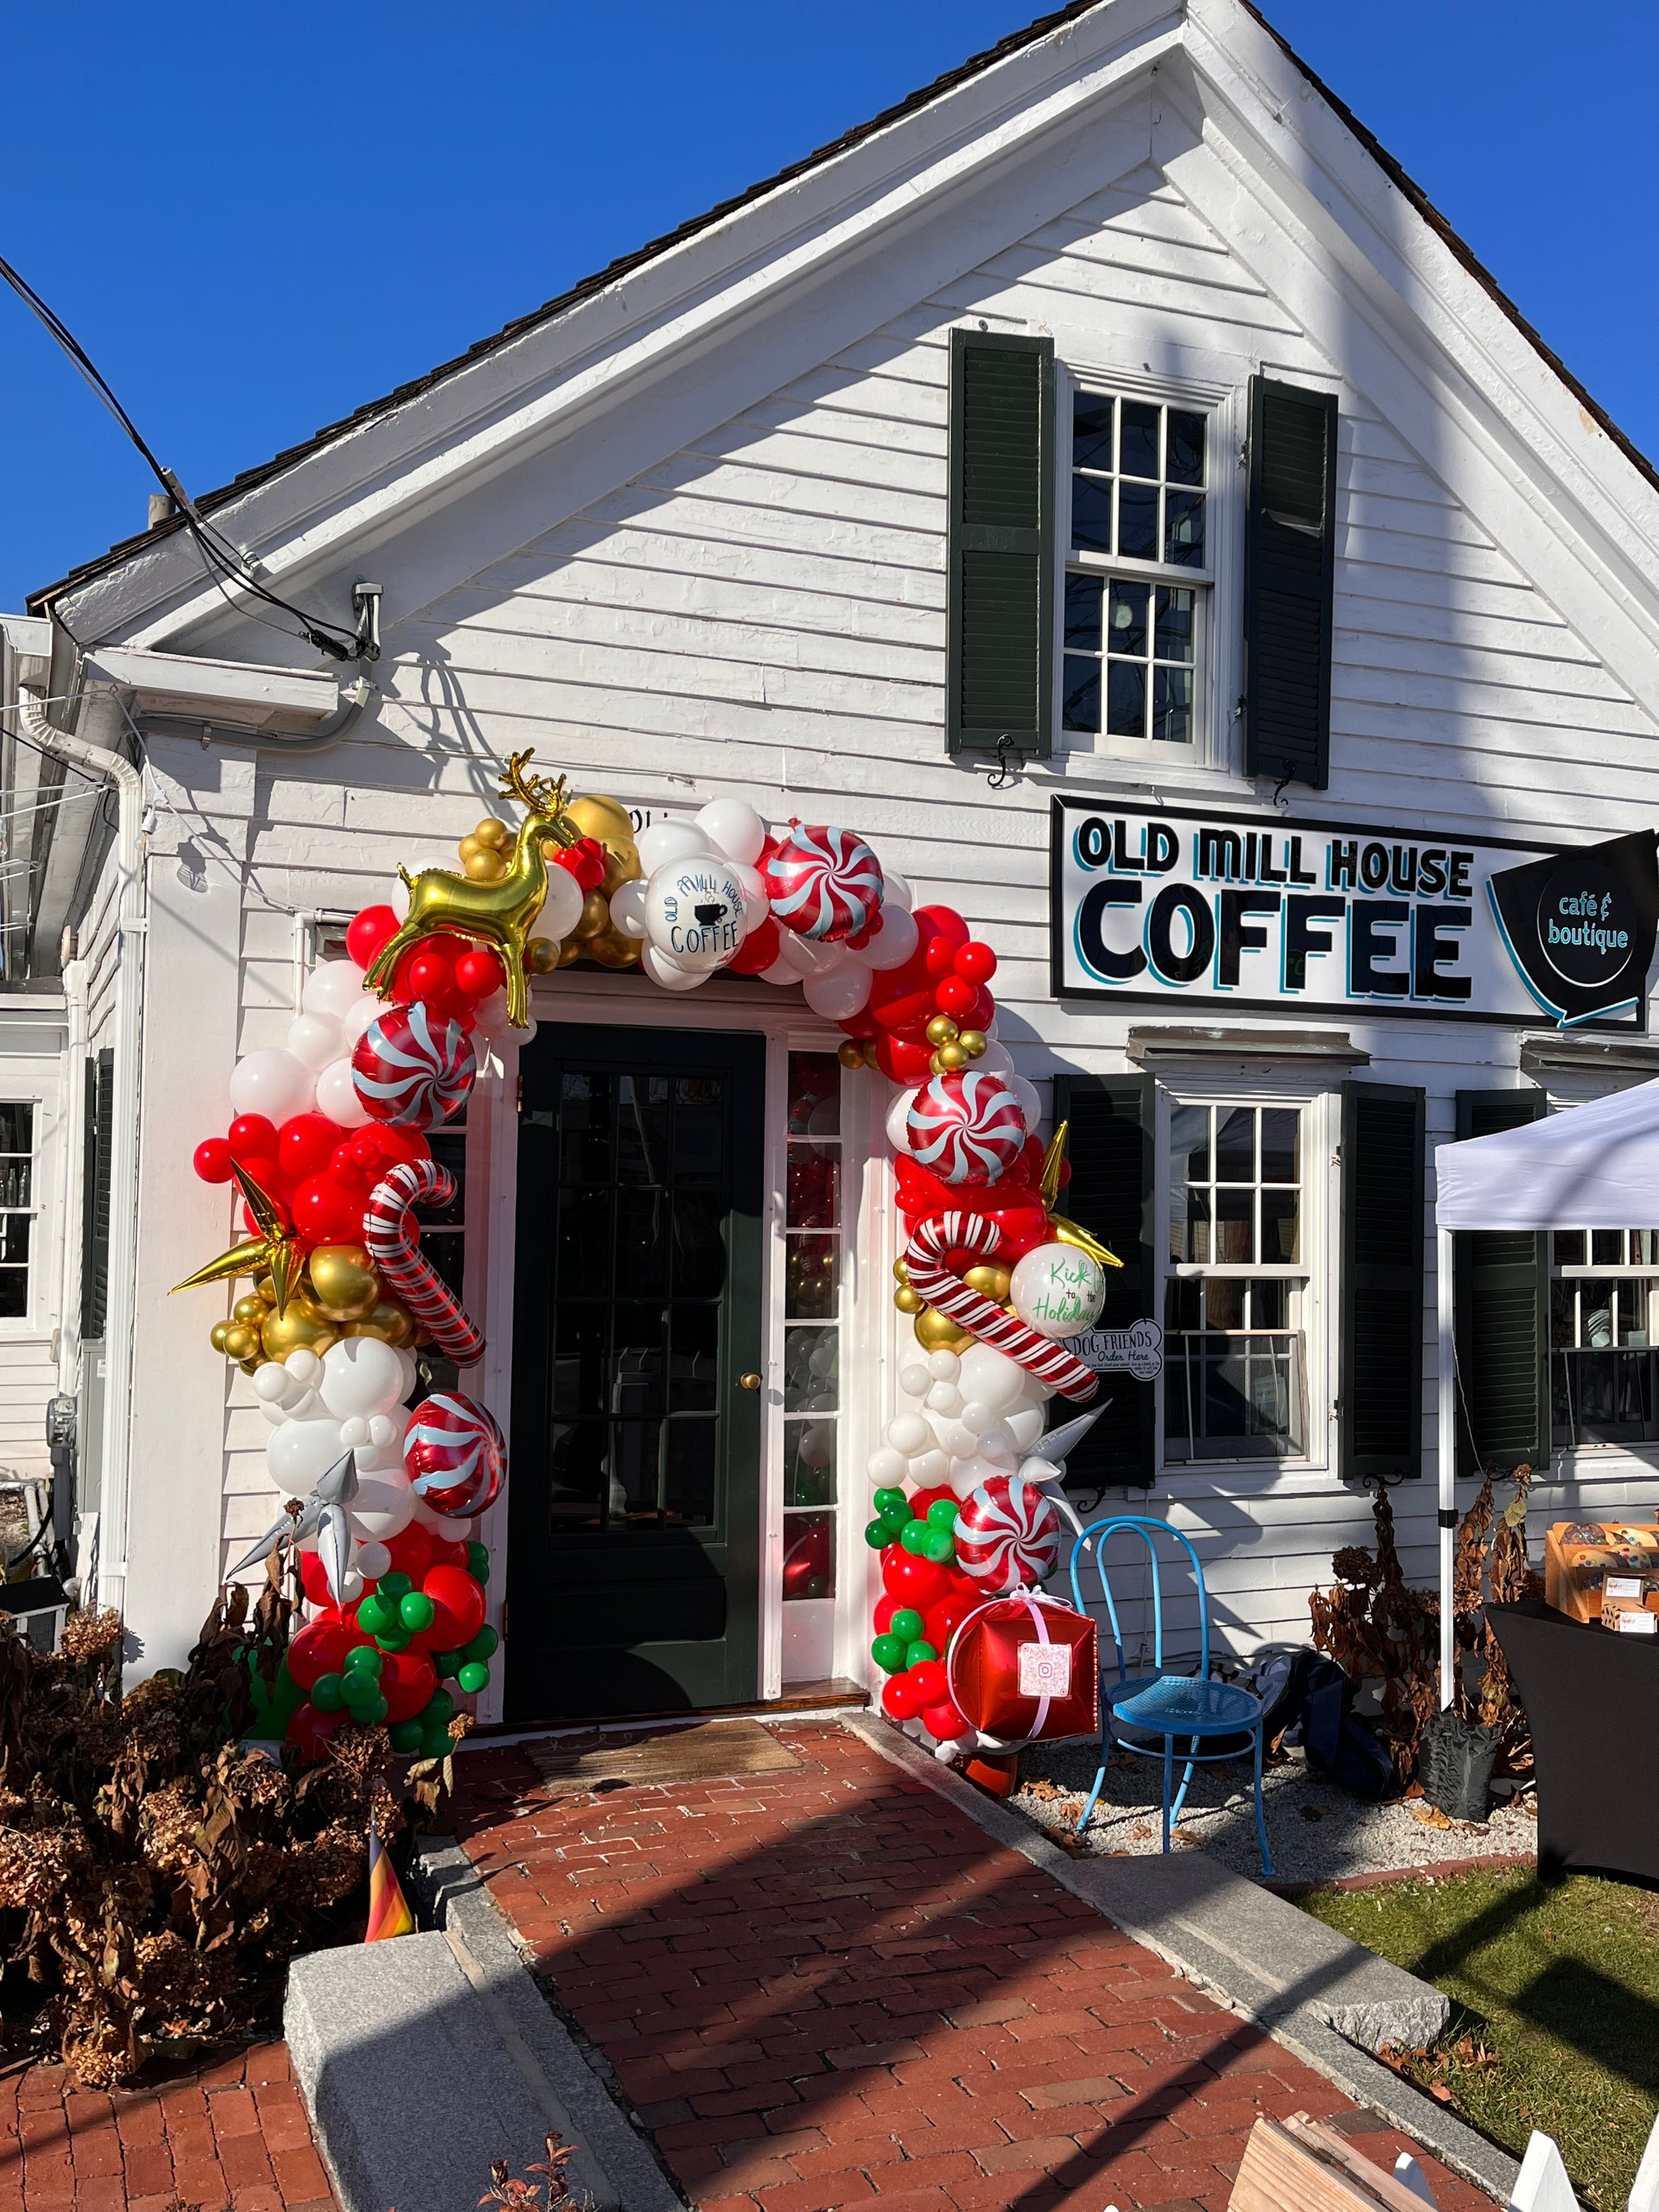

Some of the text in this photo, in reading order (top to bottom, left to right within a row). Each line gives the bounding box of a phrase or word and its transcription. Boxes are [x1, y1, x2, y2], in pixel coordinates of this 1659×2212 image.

[1074, 816, 1179, 877] OLD
[1325, 839, 1474, 901] HOUSE
[664, 896, 678, 921] OLD
[721, 880, 744, 918] HOUSE
[1559, 890, 1597, 917] café
[670, 921, 738, 953] COFFEE
[1074, 879, 1472, 1004] COFFEE
[1548, 918, 1629, 955] boutique
[1050, 1257, 1092, 1288] Kick
[1065, 1288, 1096, 1303] to the
[1073, 1330, 1152, 1356] DOG FRIENDS
[1097, 1350, 1150, 1362] Order Here
